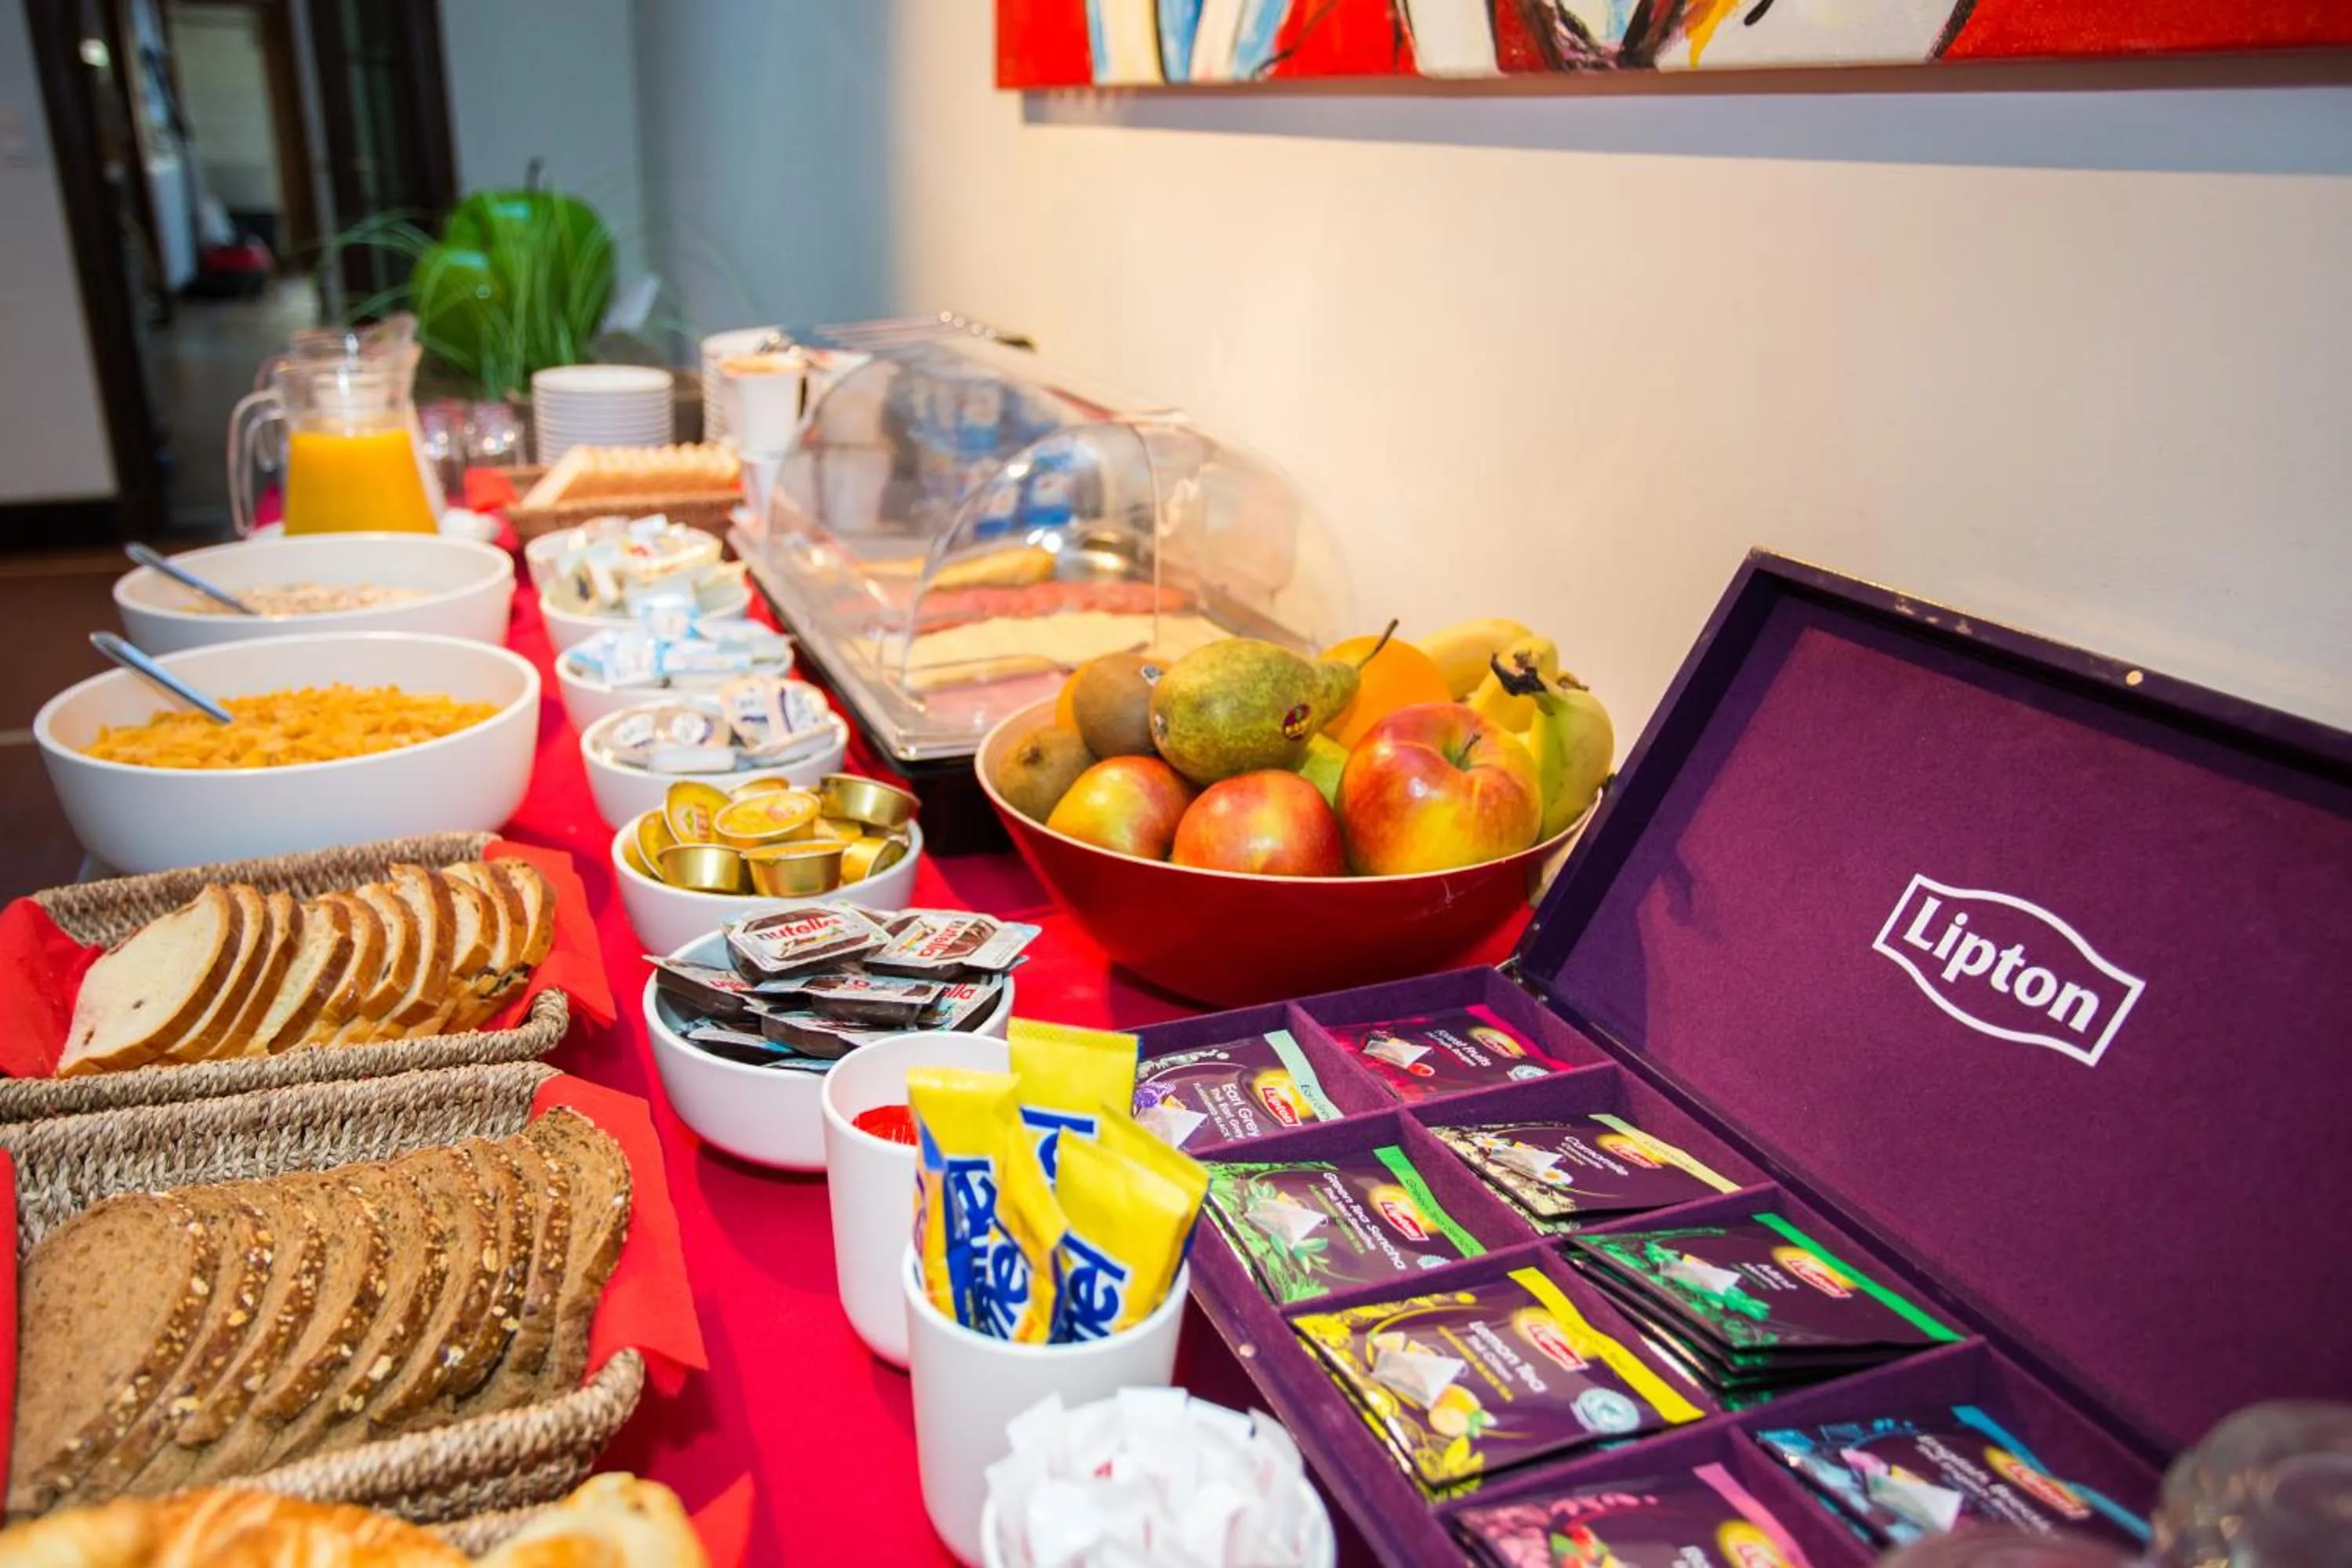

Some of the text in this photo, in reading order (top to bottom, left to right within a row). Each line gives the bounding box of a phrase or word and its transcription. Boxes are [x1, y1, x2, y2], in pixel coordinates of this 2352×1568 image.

[1903, 896, 2100, 1033] Lipton
[1221, 1083, 1263, 1138] Earl Grey
[1264, 1087, 1294, 1124] Lipton
[1367, 1224, 1407, 1271] Sencha
